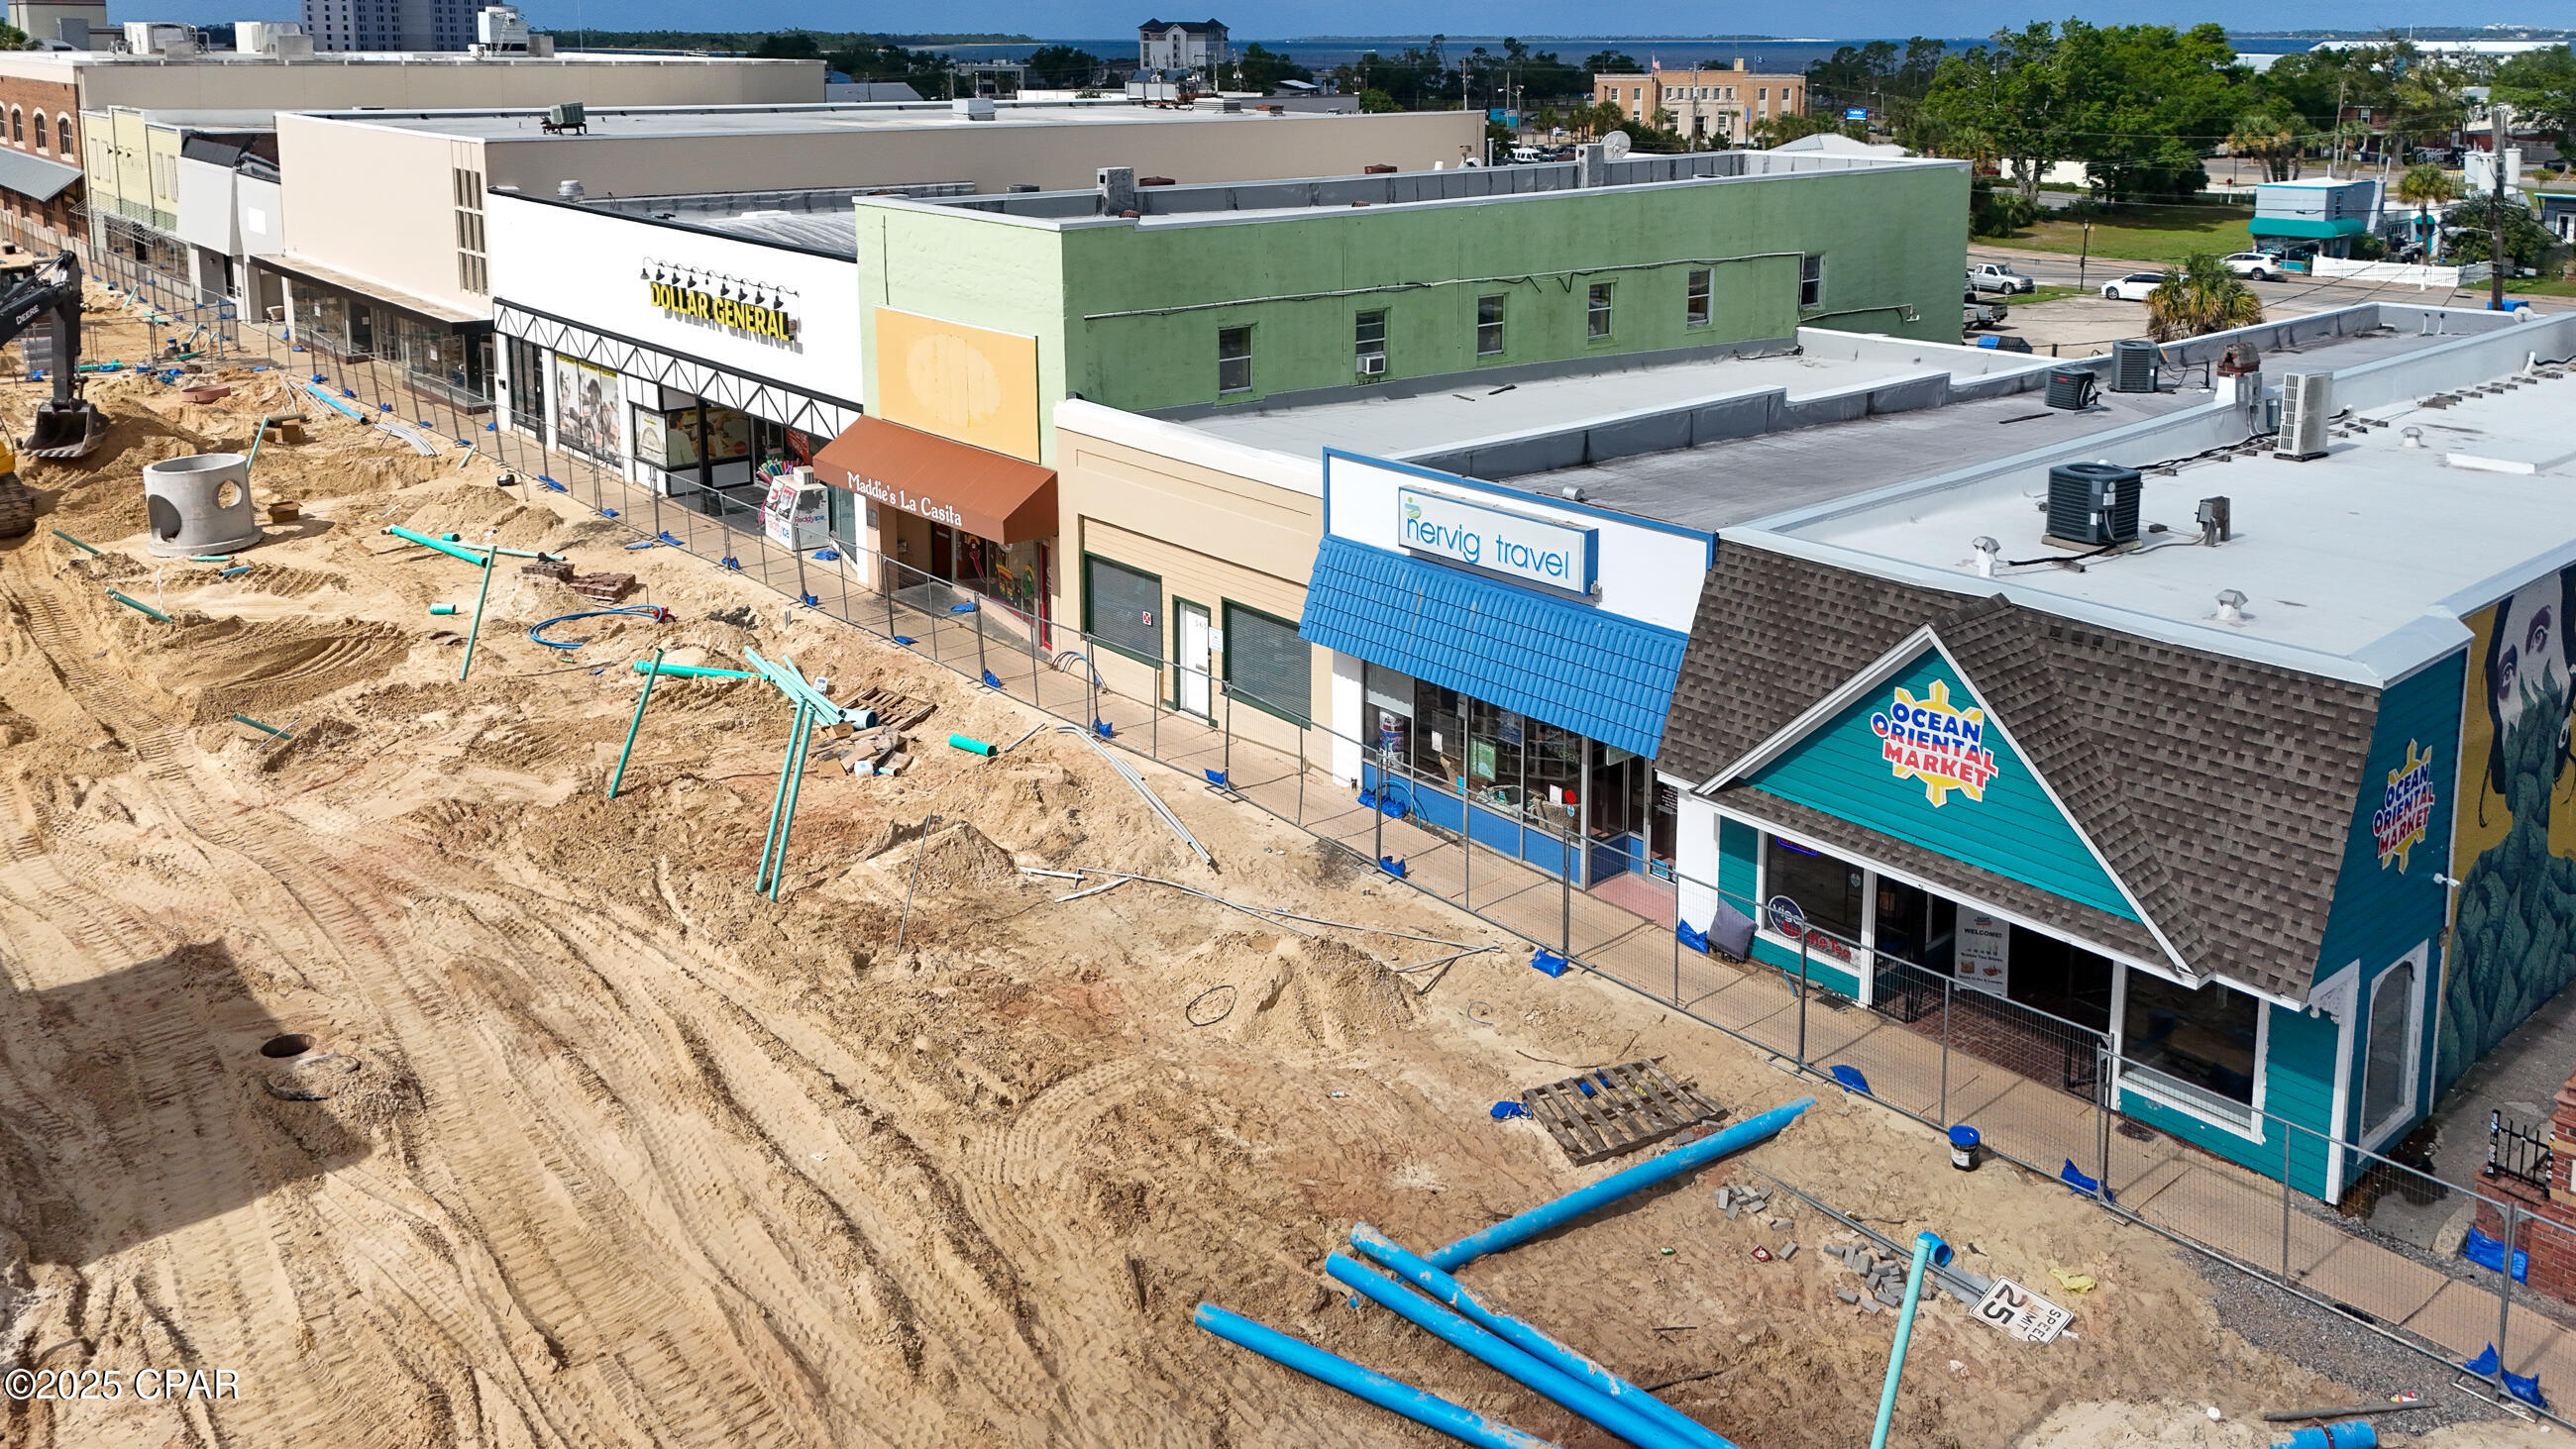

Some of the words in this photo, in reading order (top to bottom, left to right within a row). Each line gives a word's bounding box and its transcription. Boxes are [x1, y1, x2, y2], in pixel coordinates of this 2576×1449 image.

[15, 304, 40, 325] DEERE
[650, 281, 710, 320] DOLLAR
[712, 297, 790, 342] GENERAL
[847, 470, 897, 505] Maddie's
[900, 489, 916, 512] La
[920, 496, 963, 527] Casita
[1406, 517, 1481, 565] nervig
[1495, 534, 1569, 580] travel
[1872, 714, 1997, 775] ORIENTAL
[1891, 702, 1981, 743] OCEAN
[1883, 741, 1988, 788] MARKET
[2385, 762, 2429, 808] OCEAN
[2373, 782, 2434, 836] ORIENTAL
[2378, 805, 2429, 857] MARKET
[1828, 937, 1852, 960] Tea
[1982, 1283, 2028, 1325] 25
